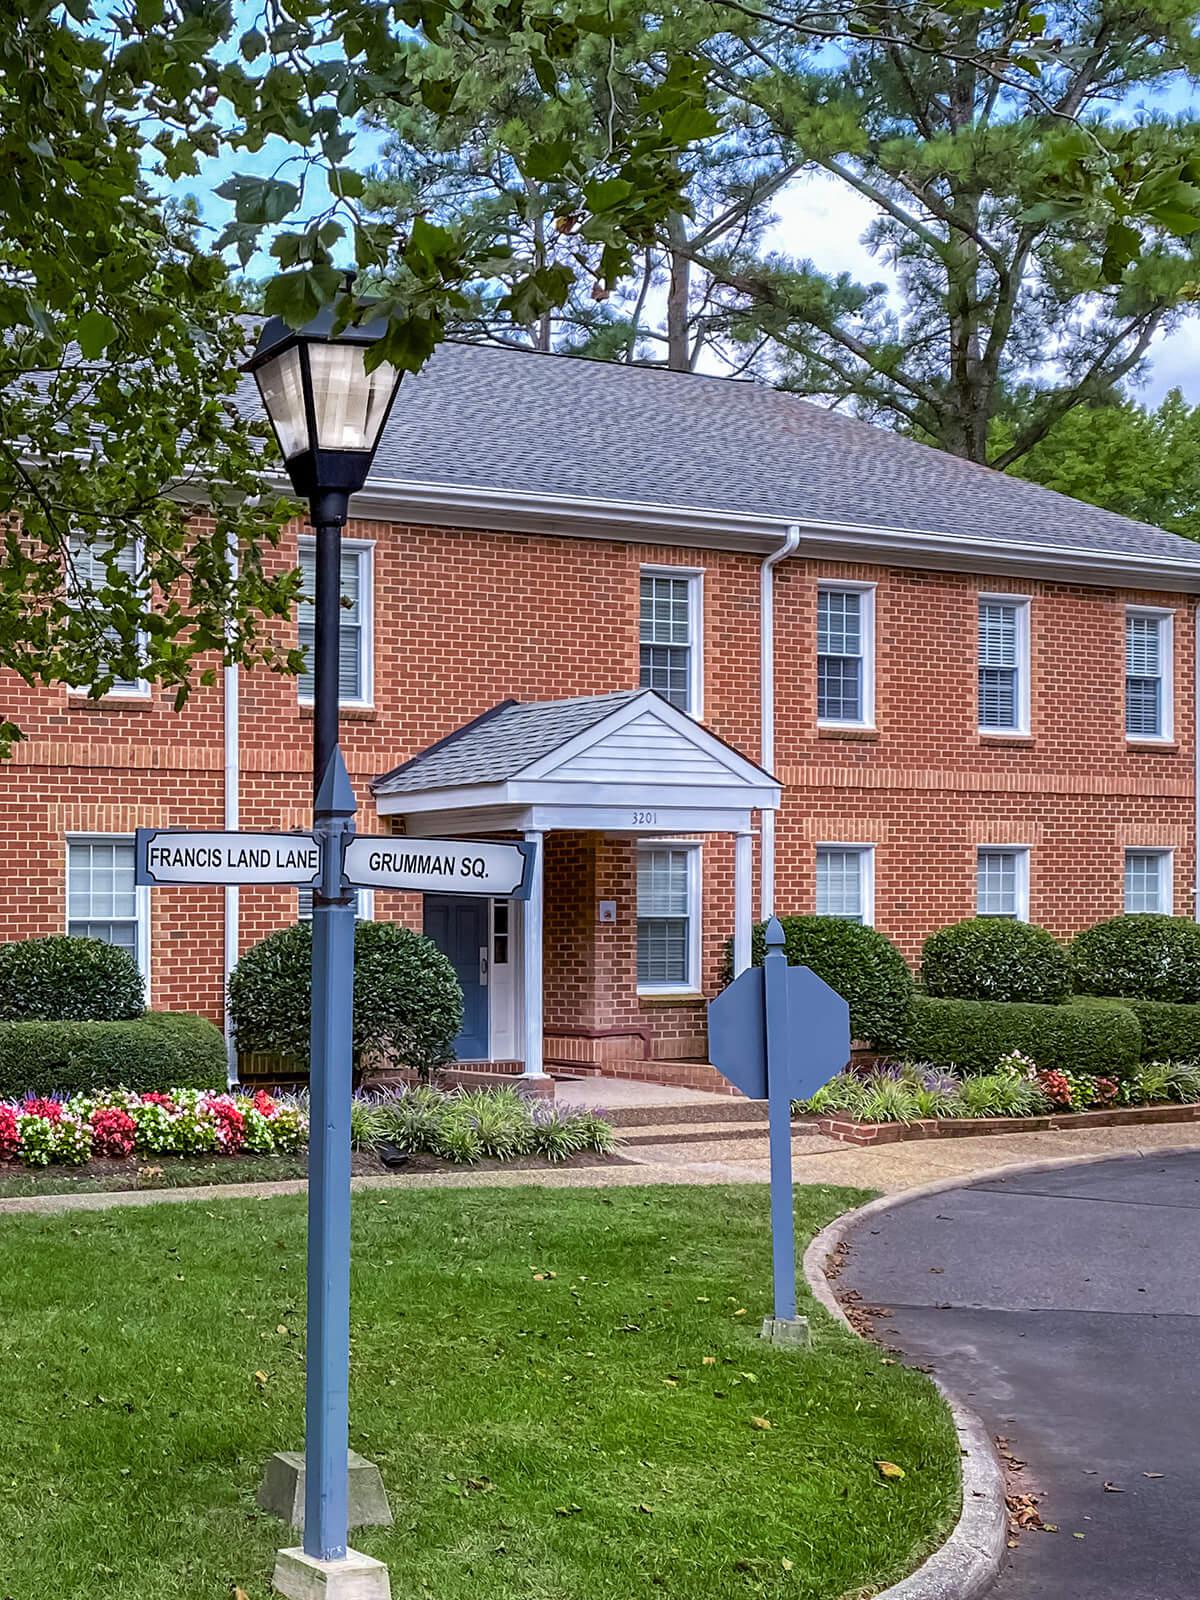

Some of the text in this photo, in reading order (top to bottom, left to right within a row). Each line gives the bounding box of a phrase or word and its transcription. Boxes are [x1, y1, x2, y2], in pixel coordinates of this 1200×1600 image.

[631, 811, 657, 825] 3201
[150, 848, 318, 869] FRANCIS LAND LANE
[369, 852, 489, 879] GRUMMAN SQ.
